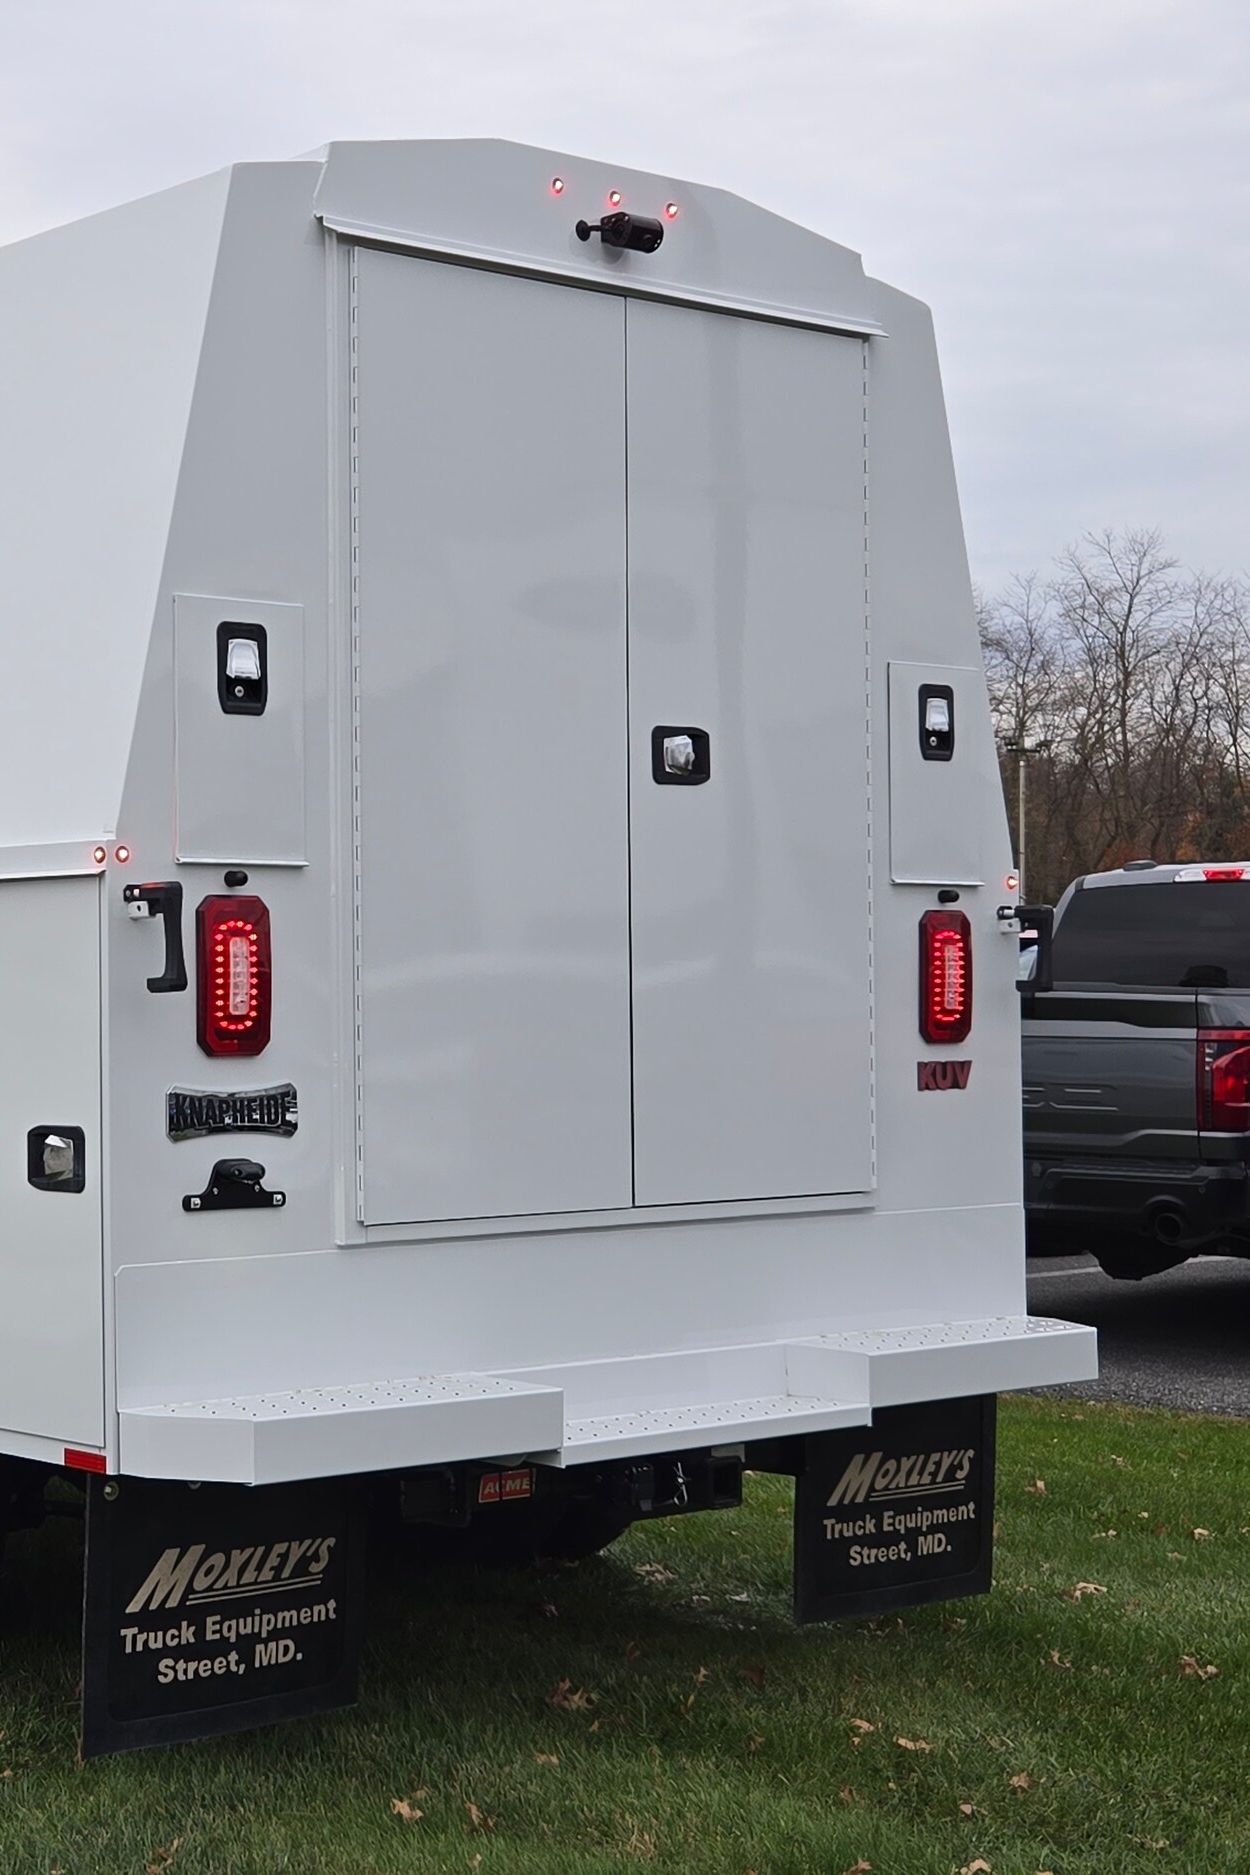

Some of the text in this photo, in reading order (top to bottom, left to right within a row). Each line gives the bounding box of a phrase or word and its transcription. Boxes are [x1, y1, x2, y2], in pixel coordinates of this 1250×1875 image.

[917, 1060, 973, 1091] KUV
[171, 1090, 297, 1130] KNAPHEIDE
[826, 1449, 975, 1507] MOXLEY'S
[823, 1501, 976, 1540] Truck Equipment
[849, 1534, 952, 1567] Street, MD.
[125, 1538, 336, 1614] MOXLEY'S
[120, 1599, 338, 1654] Truck Equipment
[157, 1638, 303, 1684] Street, MD.
